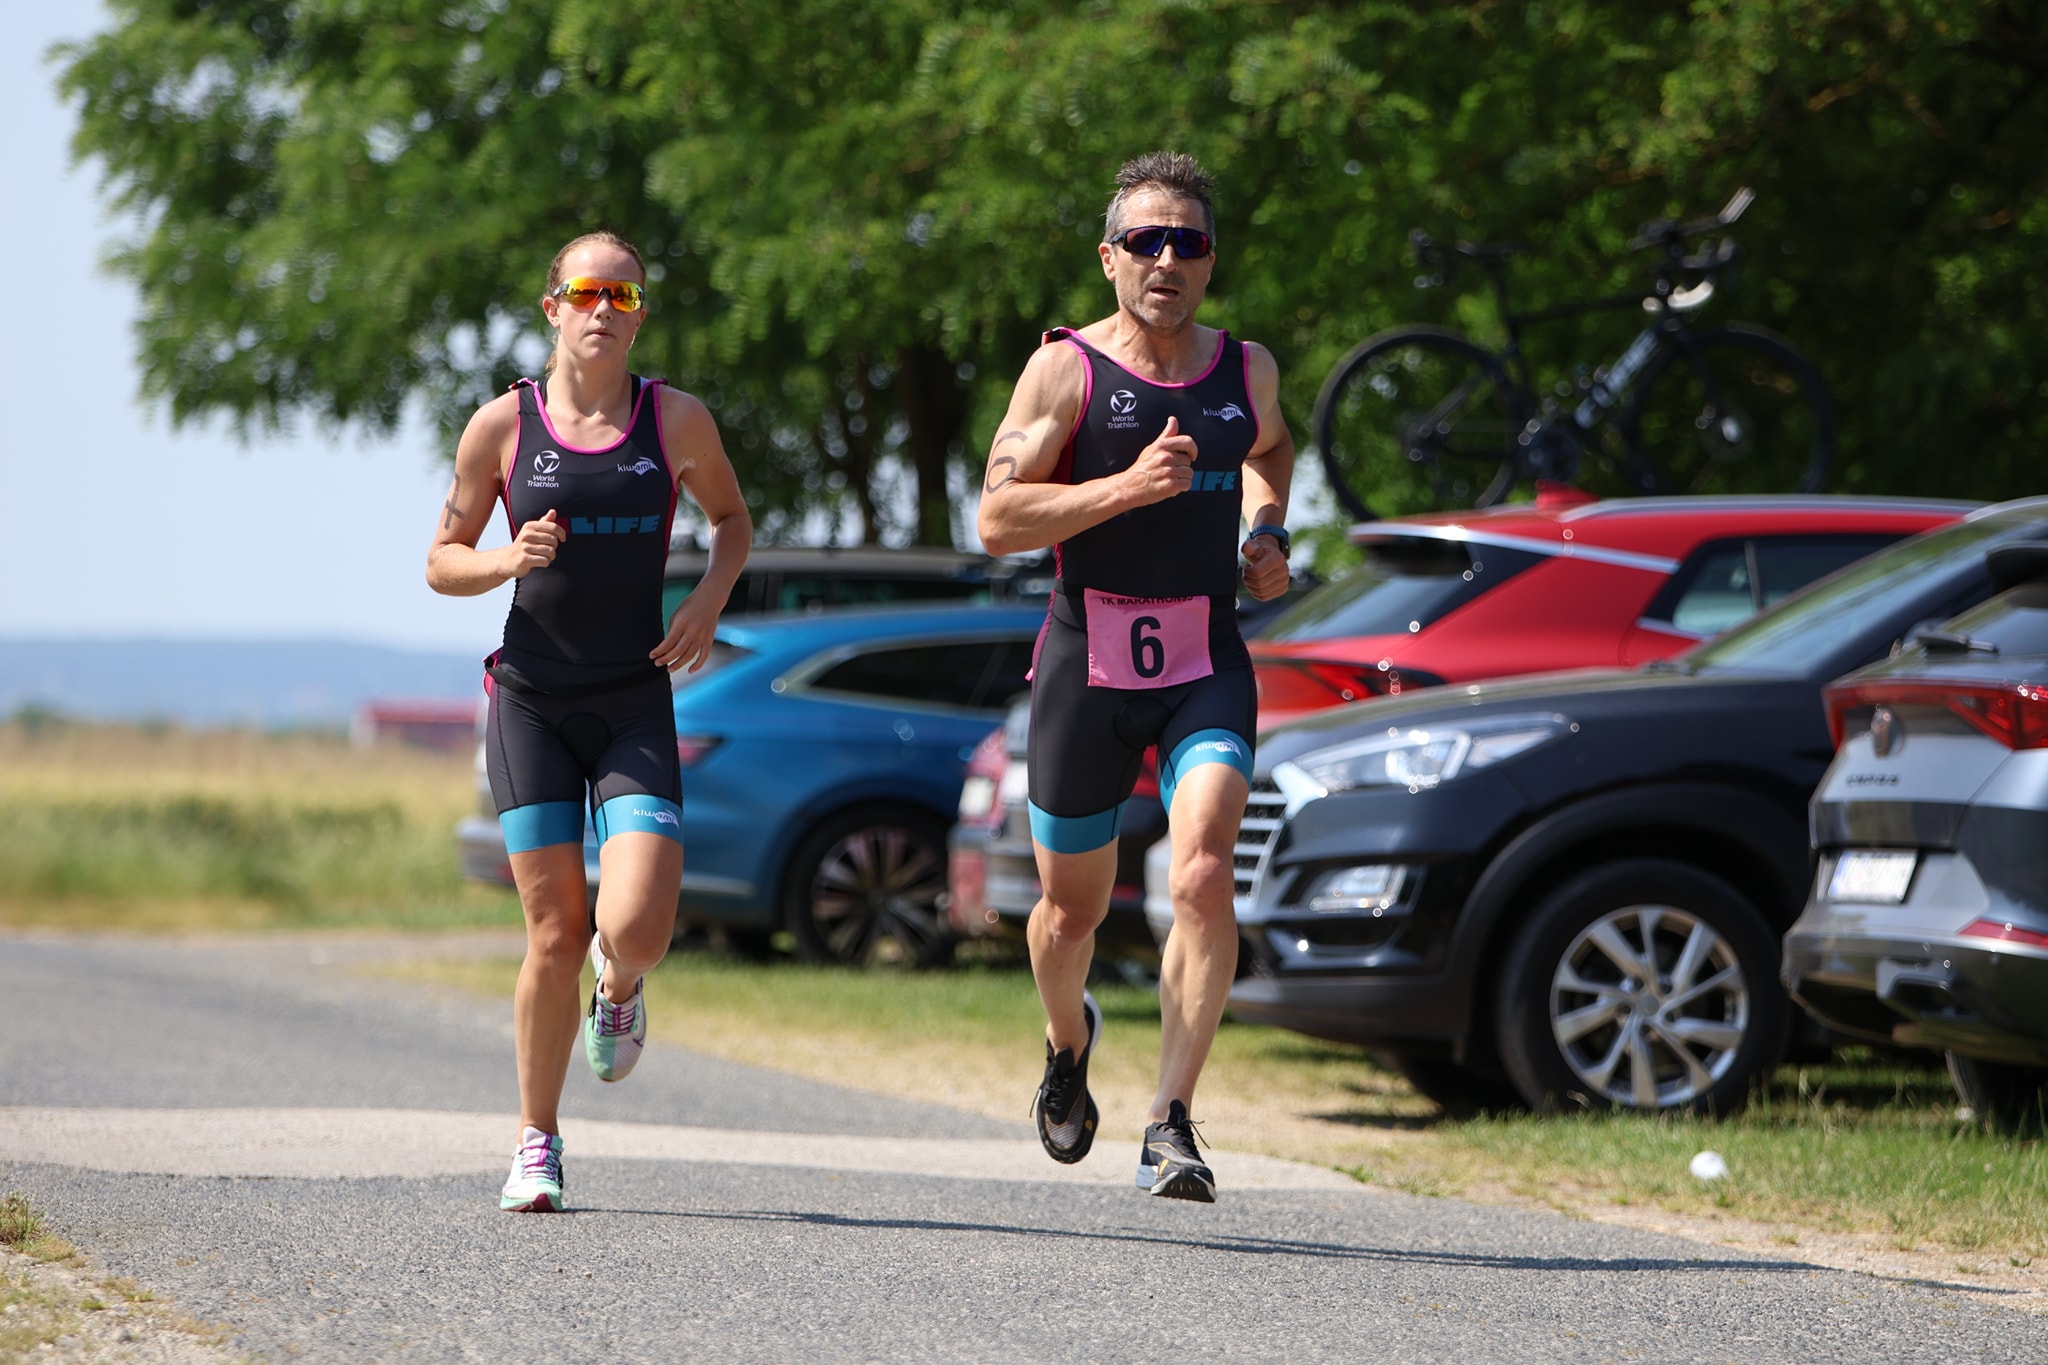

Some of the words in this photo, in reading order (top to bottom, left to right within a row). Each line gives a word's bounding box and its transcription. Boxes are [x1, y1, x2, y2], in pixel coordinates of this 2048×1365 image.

[1202, 407, 1239, 418] kiwami
[1112, 414, 1135, 423] World
[1107, 422, 1140, 430] Triathlon
[985, 430, 1028, 494] 6
[617, 462, 653, 474] kiwami
[532, 474, 555, 482] World
[1190, 470, 1237, 492] IFE
[527, 480, 560, 489] Triathlon
[1130, 615, 1165, 679] 6
[633, 808, 676, 824] kiwami
